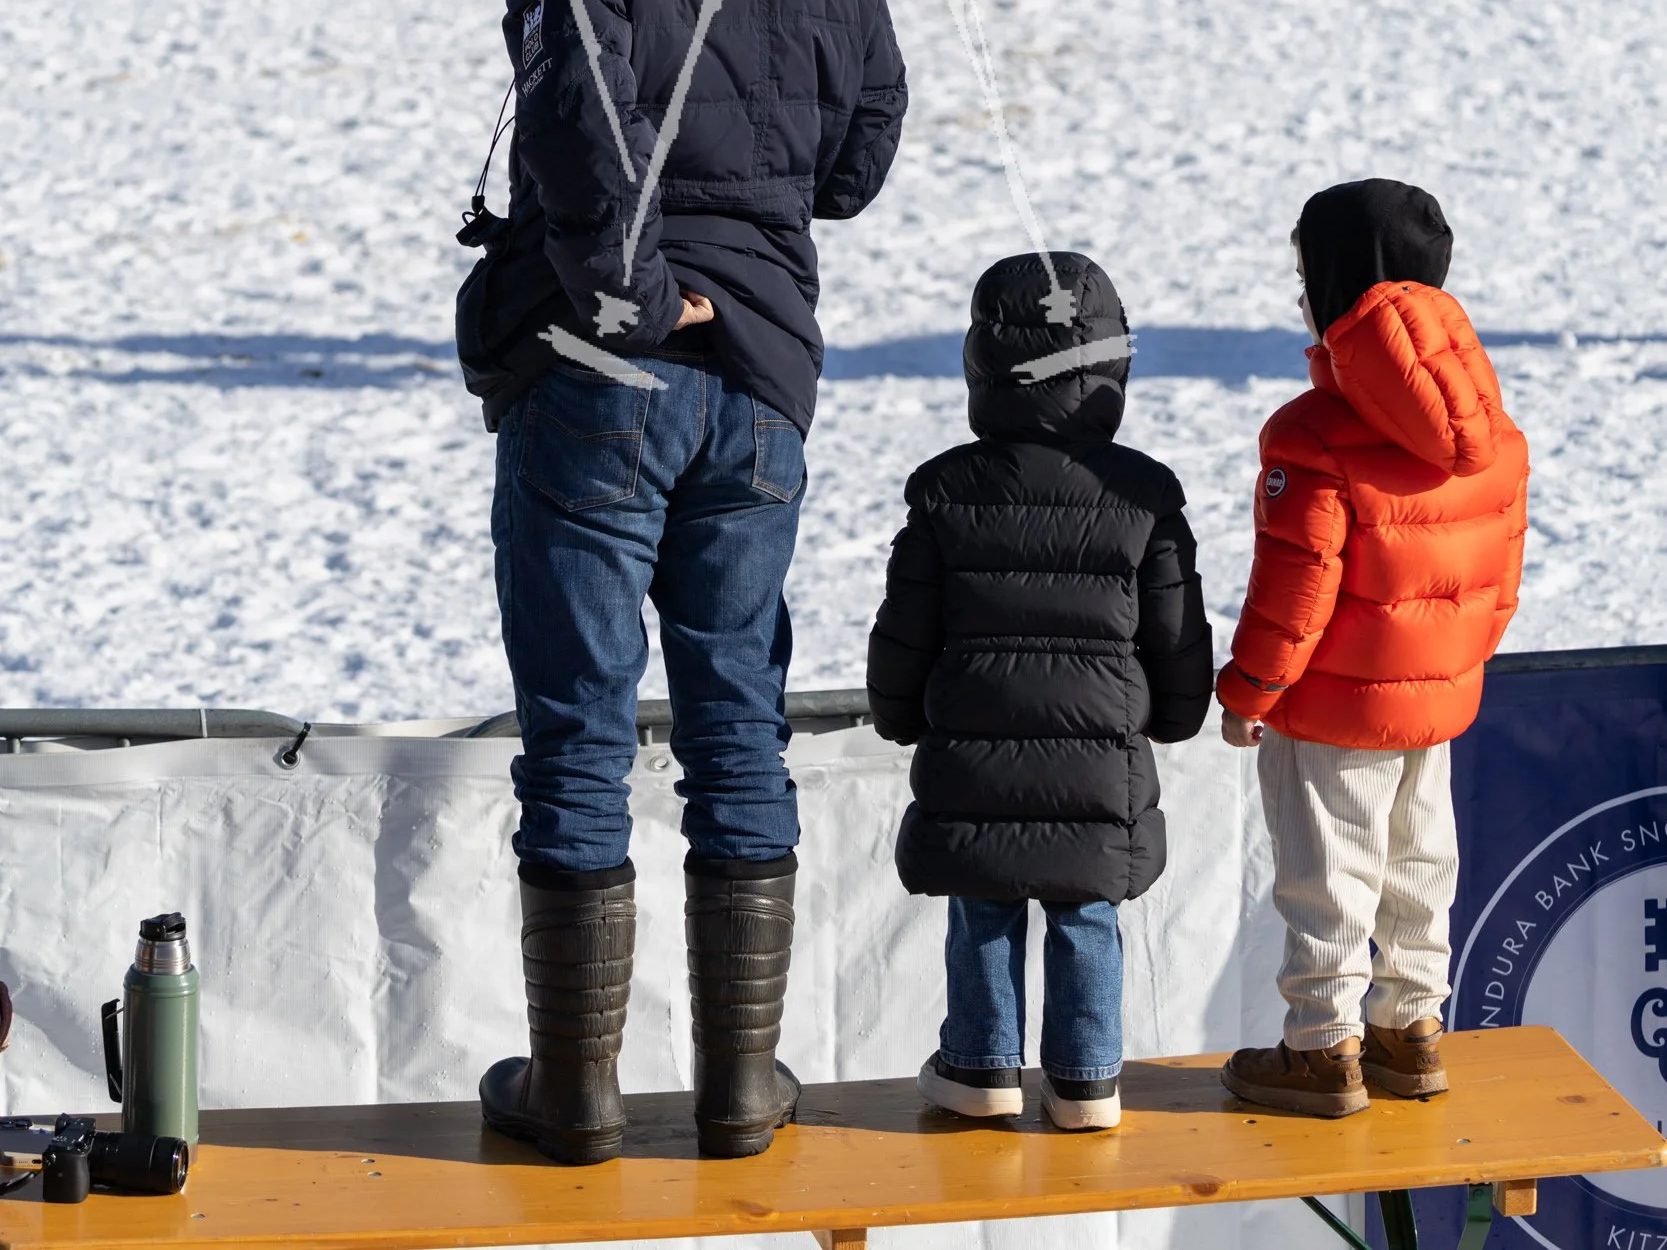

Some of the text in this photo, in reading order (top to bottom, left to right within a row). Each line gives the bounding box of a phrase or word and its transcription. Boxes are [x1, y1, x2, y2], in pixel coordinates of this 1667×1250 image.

[525, 40, 539, 62] CLUB
[521, 57, 553, 98] HACKETT
[1534, 841, 1610, 911] BANK
[1620, 820, 1667, 852] SN
